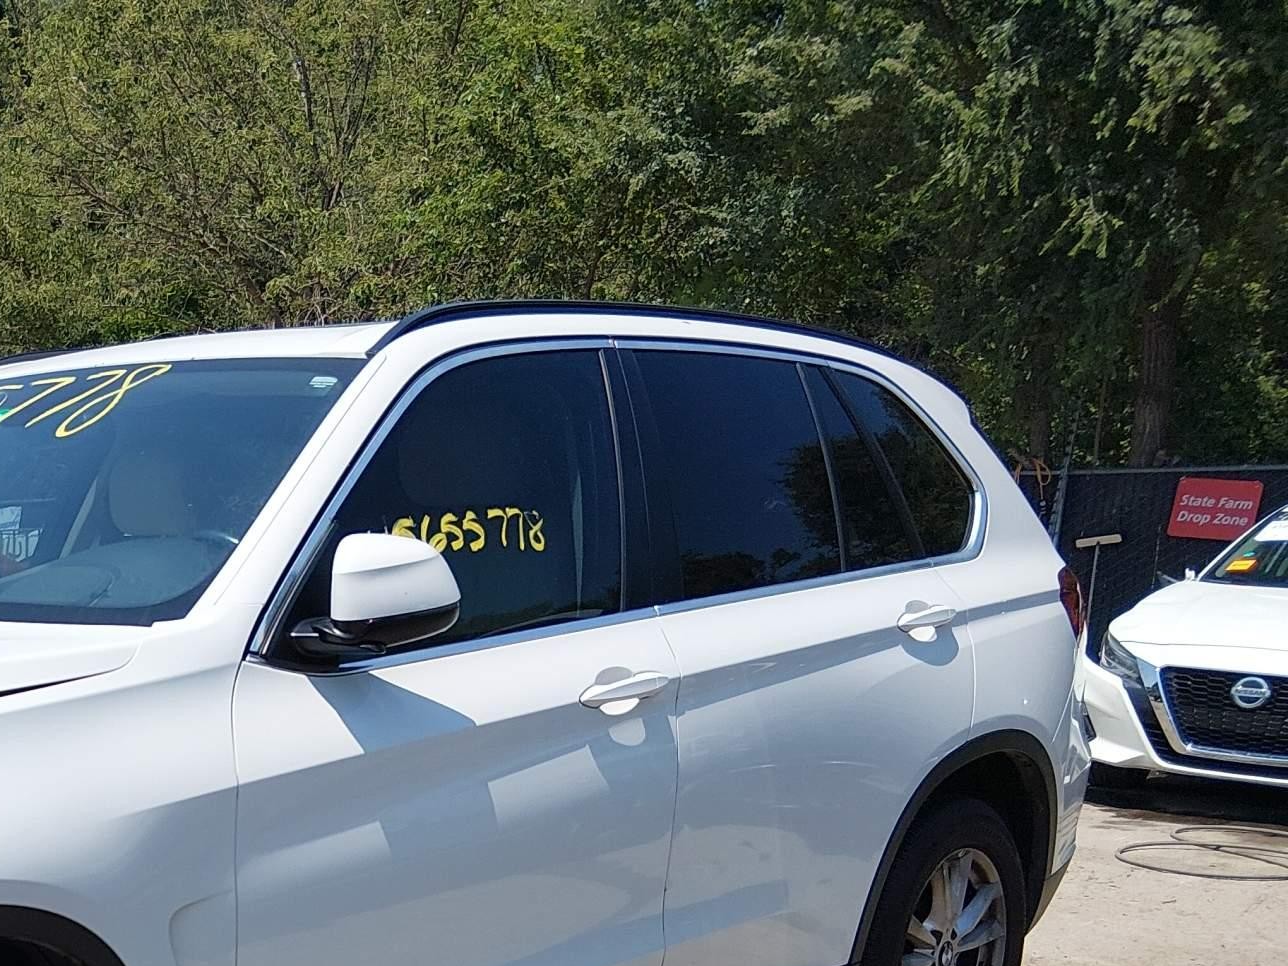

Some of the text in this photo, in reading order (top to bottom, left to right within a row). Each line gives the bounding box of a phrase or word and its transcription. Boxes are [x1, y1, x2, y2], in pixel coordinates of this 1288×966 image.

[1179, 494, 1254, 510] State Farm
[1176, 511, 1249, 526] Drop Zone
